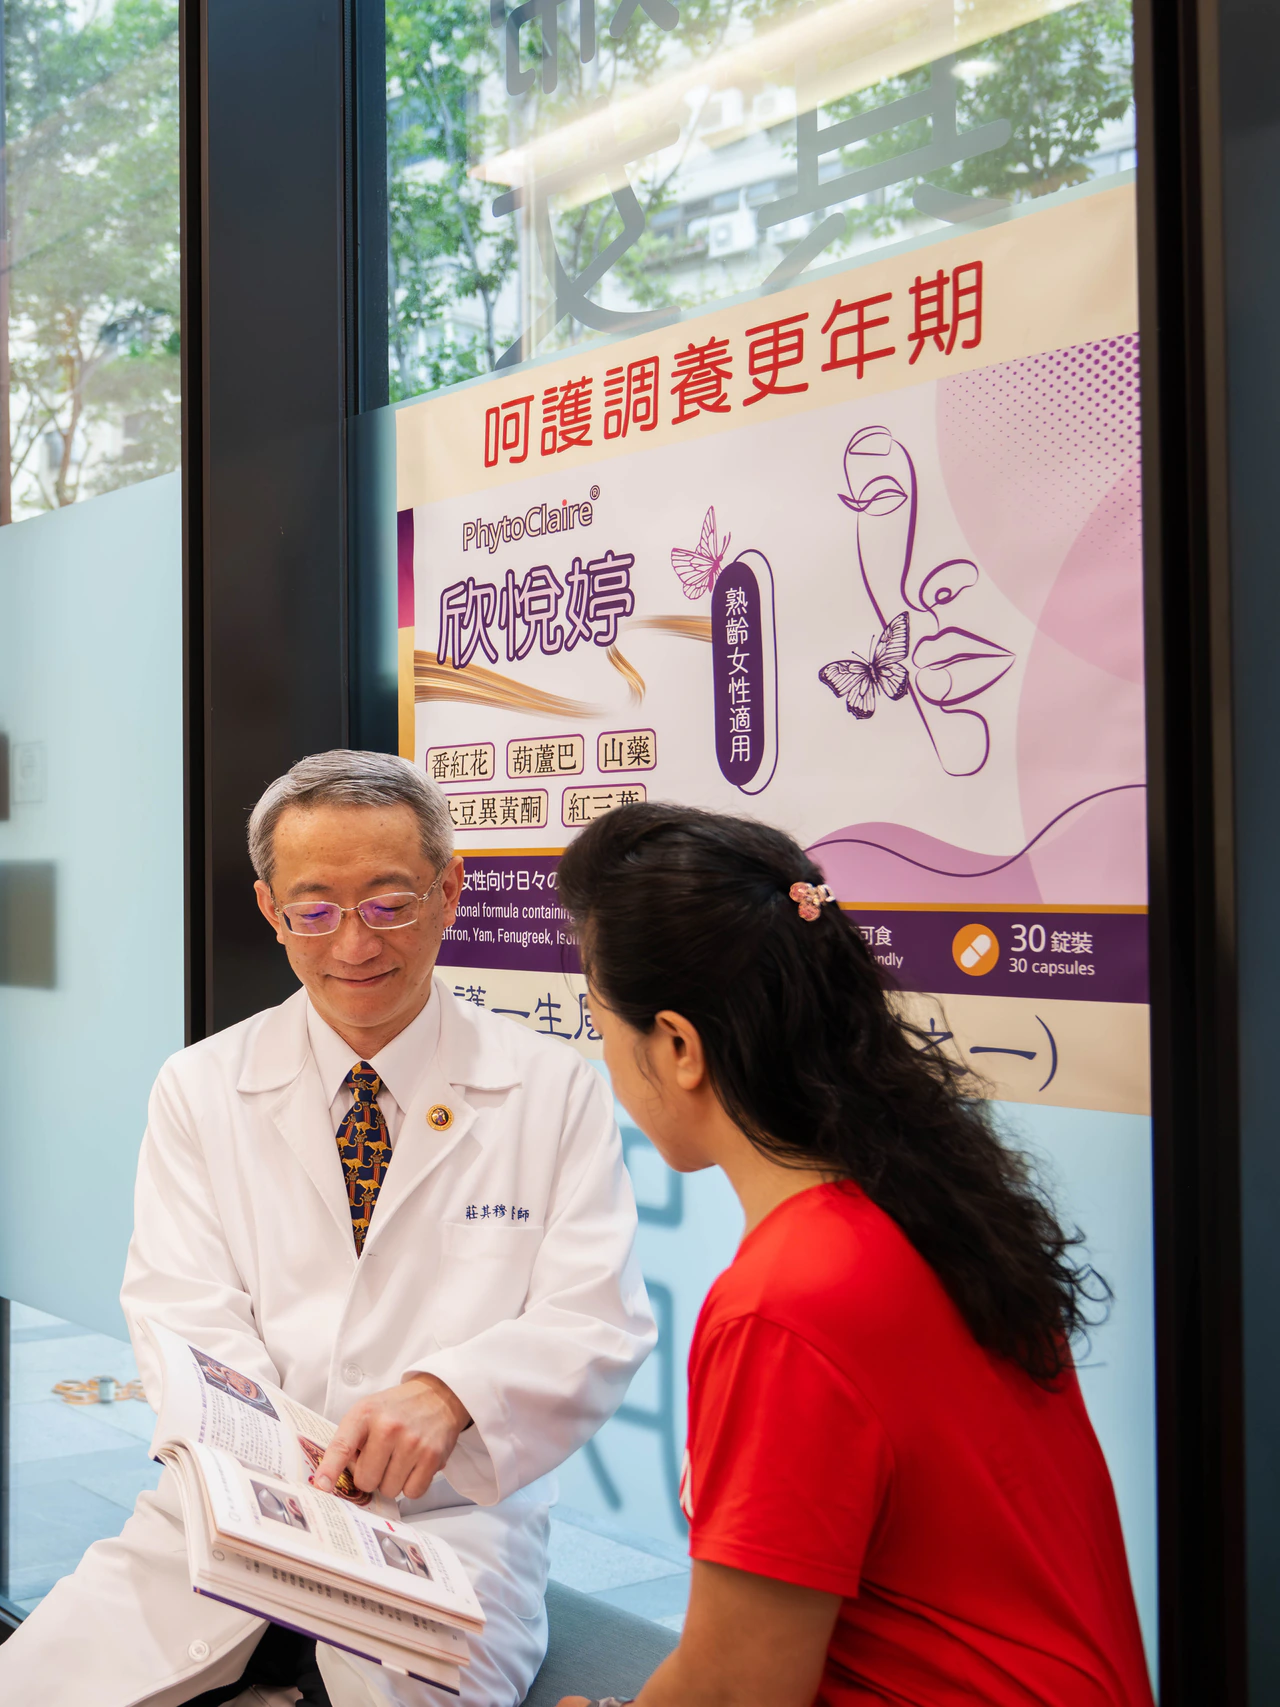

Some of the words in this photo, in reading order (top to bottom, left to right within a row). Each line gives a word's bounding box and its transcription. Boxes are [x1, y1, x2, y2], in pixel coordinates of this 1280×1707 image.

[483, 259, 984, 468] 呵護調養更年期
[436, 549, 635, 669] 欣悅婷
[725, 586, 753, 763] 熟齡女性適用
[431, 748, 489, 780] 番紅花
[513, 743, 577, 775] 葫蘆巴
[604, 735, 652, 768] 山藥
[482, 902, 519, 918] formula
[441, 926, 471, 943] affron,
[472, 927, 495, 944] Yam,
[497, 928, 554, 948] Fenugreek,
[1010, 923, 1046, 953] 30
[1050, 930, 1094, 954] 錠裝
[1008, 957, 1028, 973] 30
[1031, 960, 1095, 977] capsules
